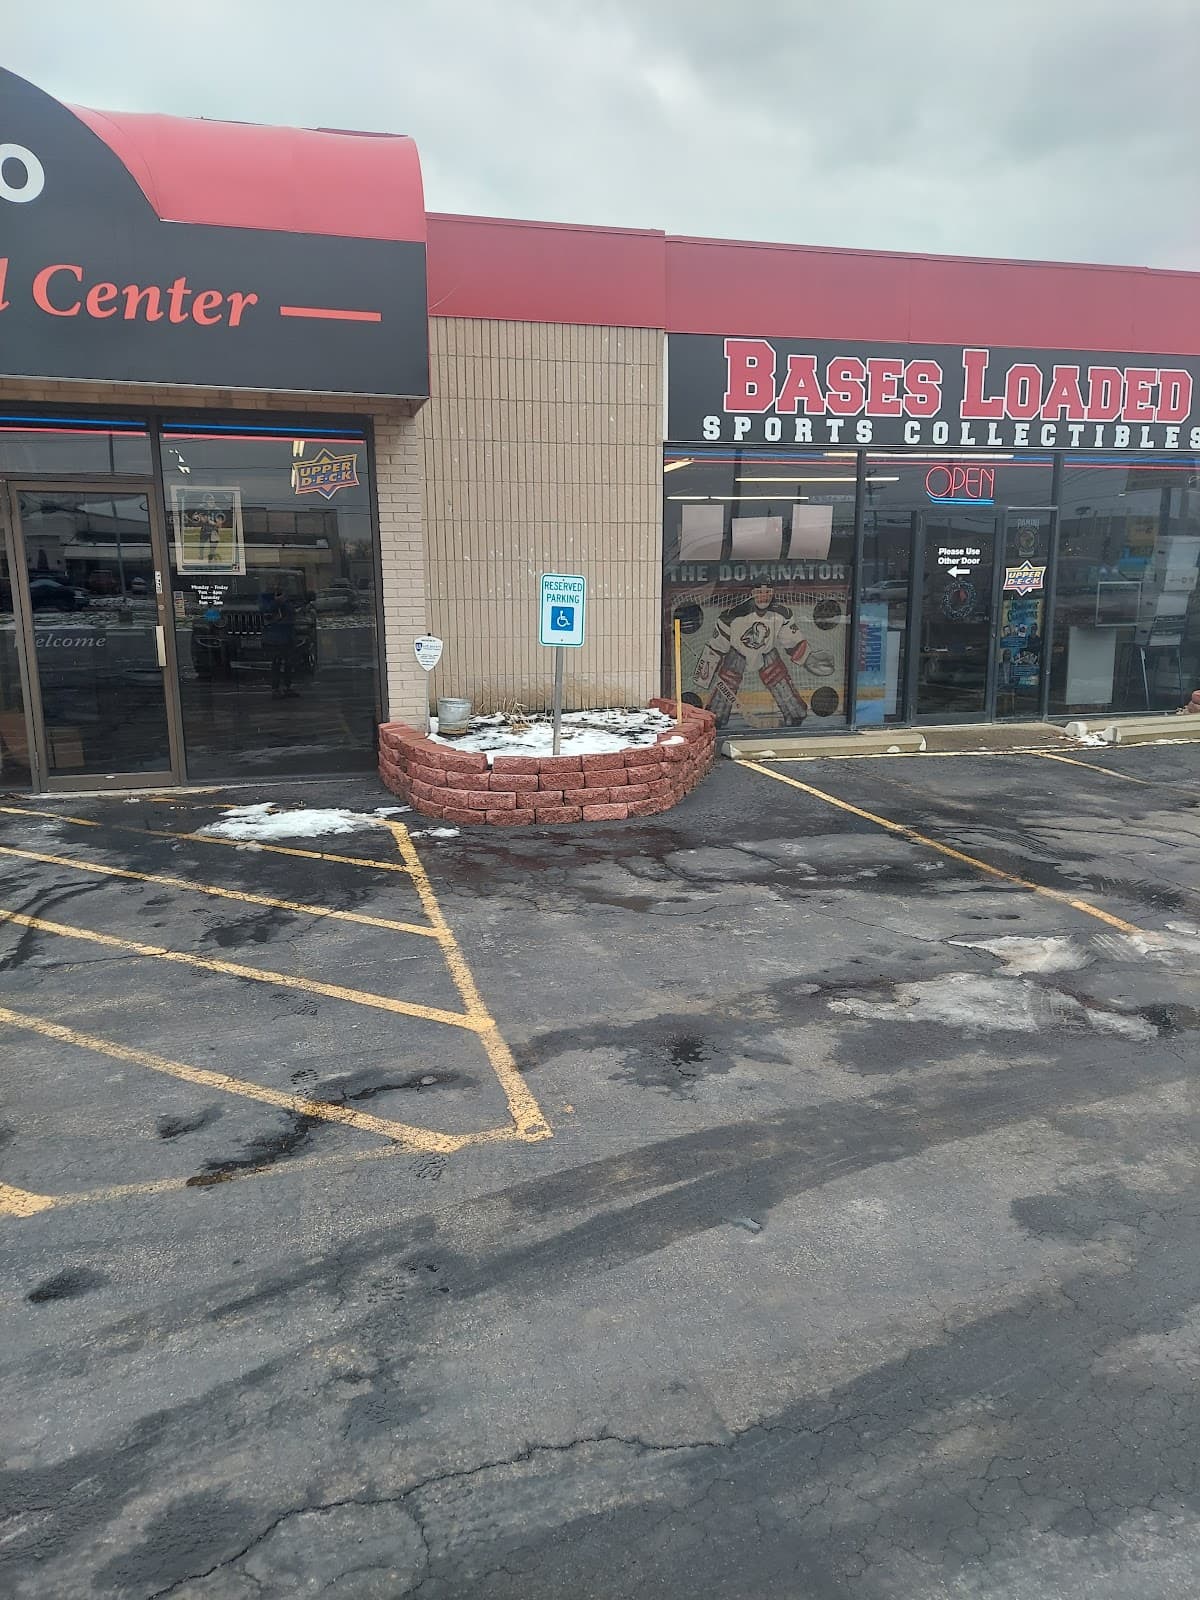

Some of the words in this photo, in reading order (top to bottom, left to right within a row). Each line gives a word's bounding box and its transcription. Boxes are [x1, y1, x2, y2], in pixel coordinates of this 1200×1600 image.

[32, 264, 258, 327] Center
[702, 415, 873, 444] SPORTS
[903, 420, 1200, 449] COLLECTIBLES
[300, 462, 351, 477] UPPER
[925, 466, 995, 498] OPEN
[938, 547, 964, 555] Please
[965, 547, 980, 555] Use
[937, 557, 960, 565] Other
[961, 557, 981, 565] Door
[670, 565, 708, 581] THE
[719, 563, 845, 581] DOMINATOR
[1008, 571, 1041, 579] UPPER
[544, 581, 582, 592] RESERVED
[547, 593, 580, 604] PARKING
[14, 633, 107, 649] elcome
